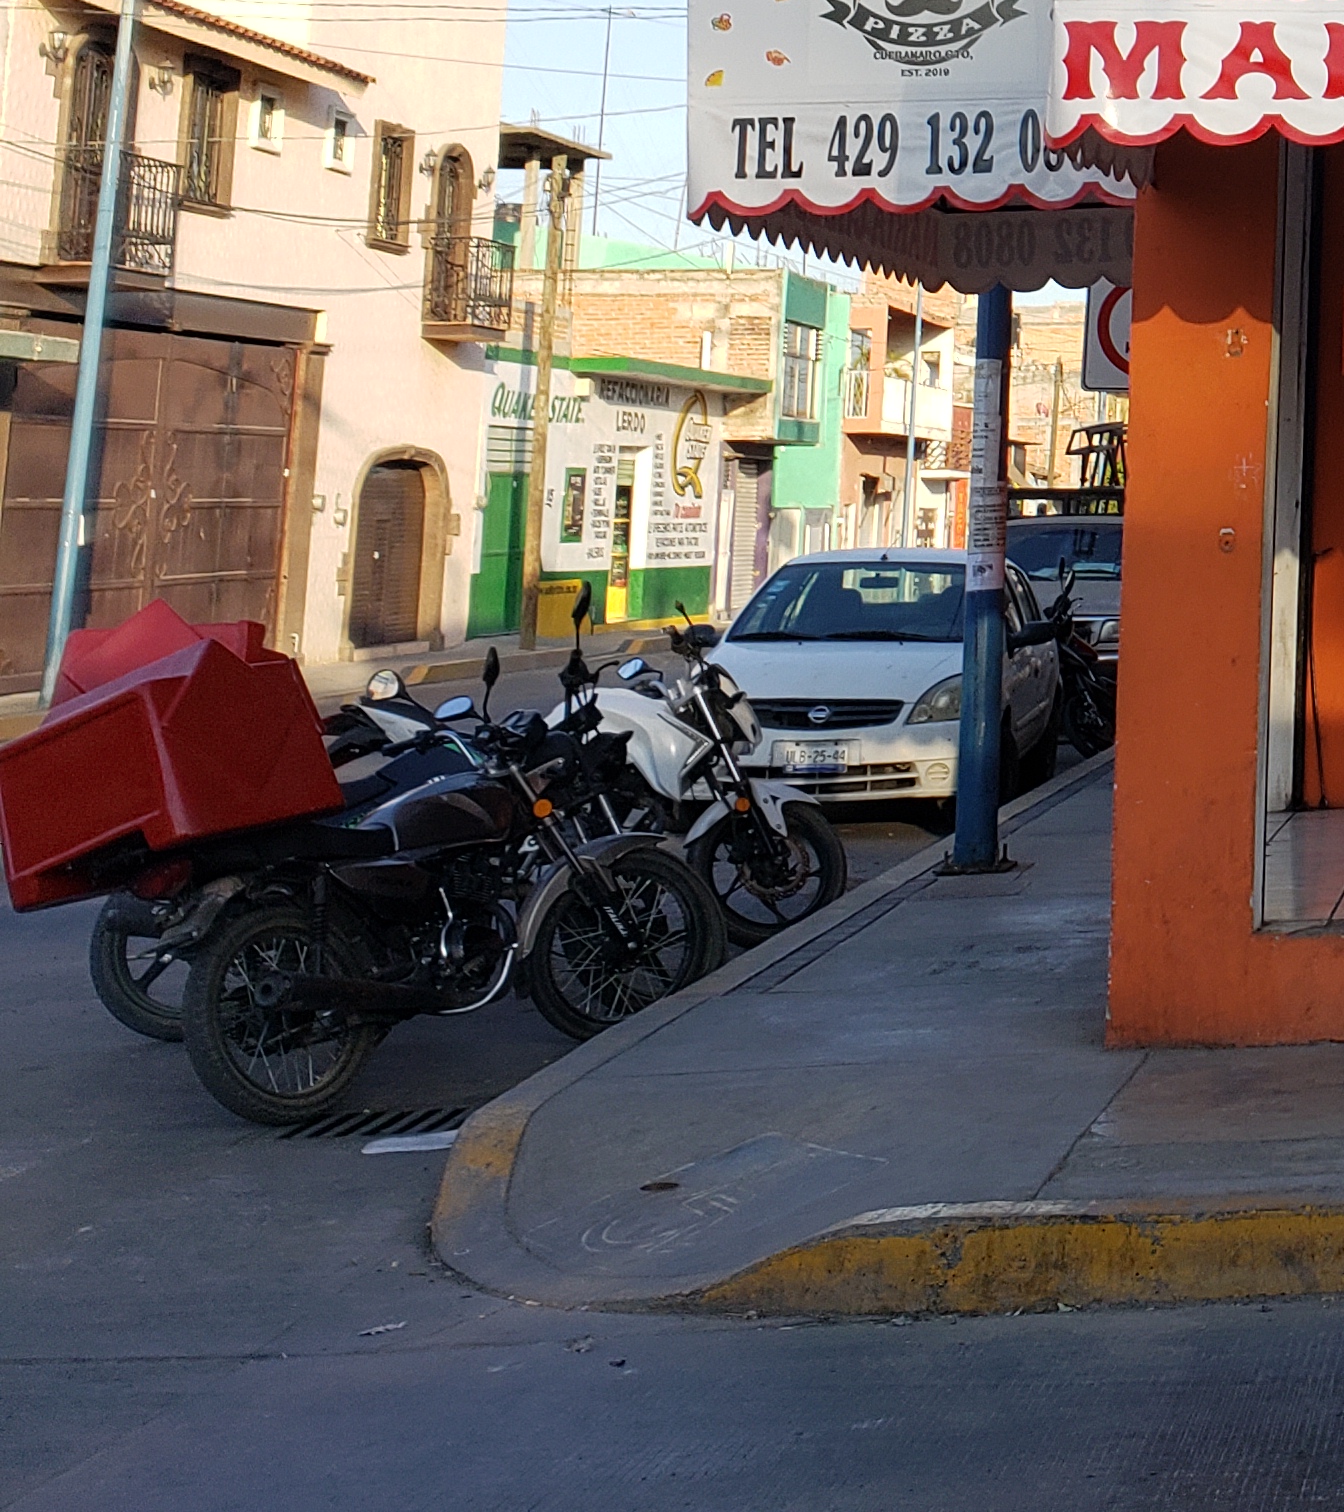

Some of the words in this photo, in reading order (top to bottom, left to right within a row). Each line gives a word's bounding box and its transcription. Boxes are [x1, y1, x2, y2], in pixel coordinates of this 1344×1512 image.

[863, 16, 983, 42] PIZZA
[900, 68, 922, 77] EST.
[924, 68, 950, 77] 2019
[731, 116, 804, 180] TEL
[827, 113, 899, 178] 429
[925, 110, 995, 175] 132
[491, 381, 536, 421] QUAKE
[616, 409, 646, 434] LERDO
